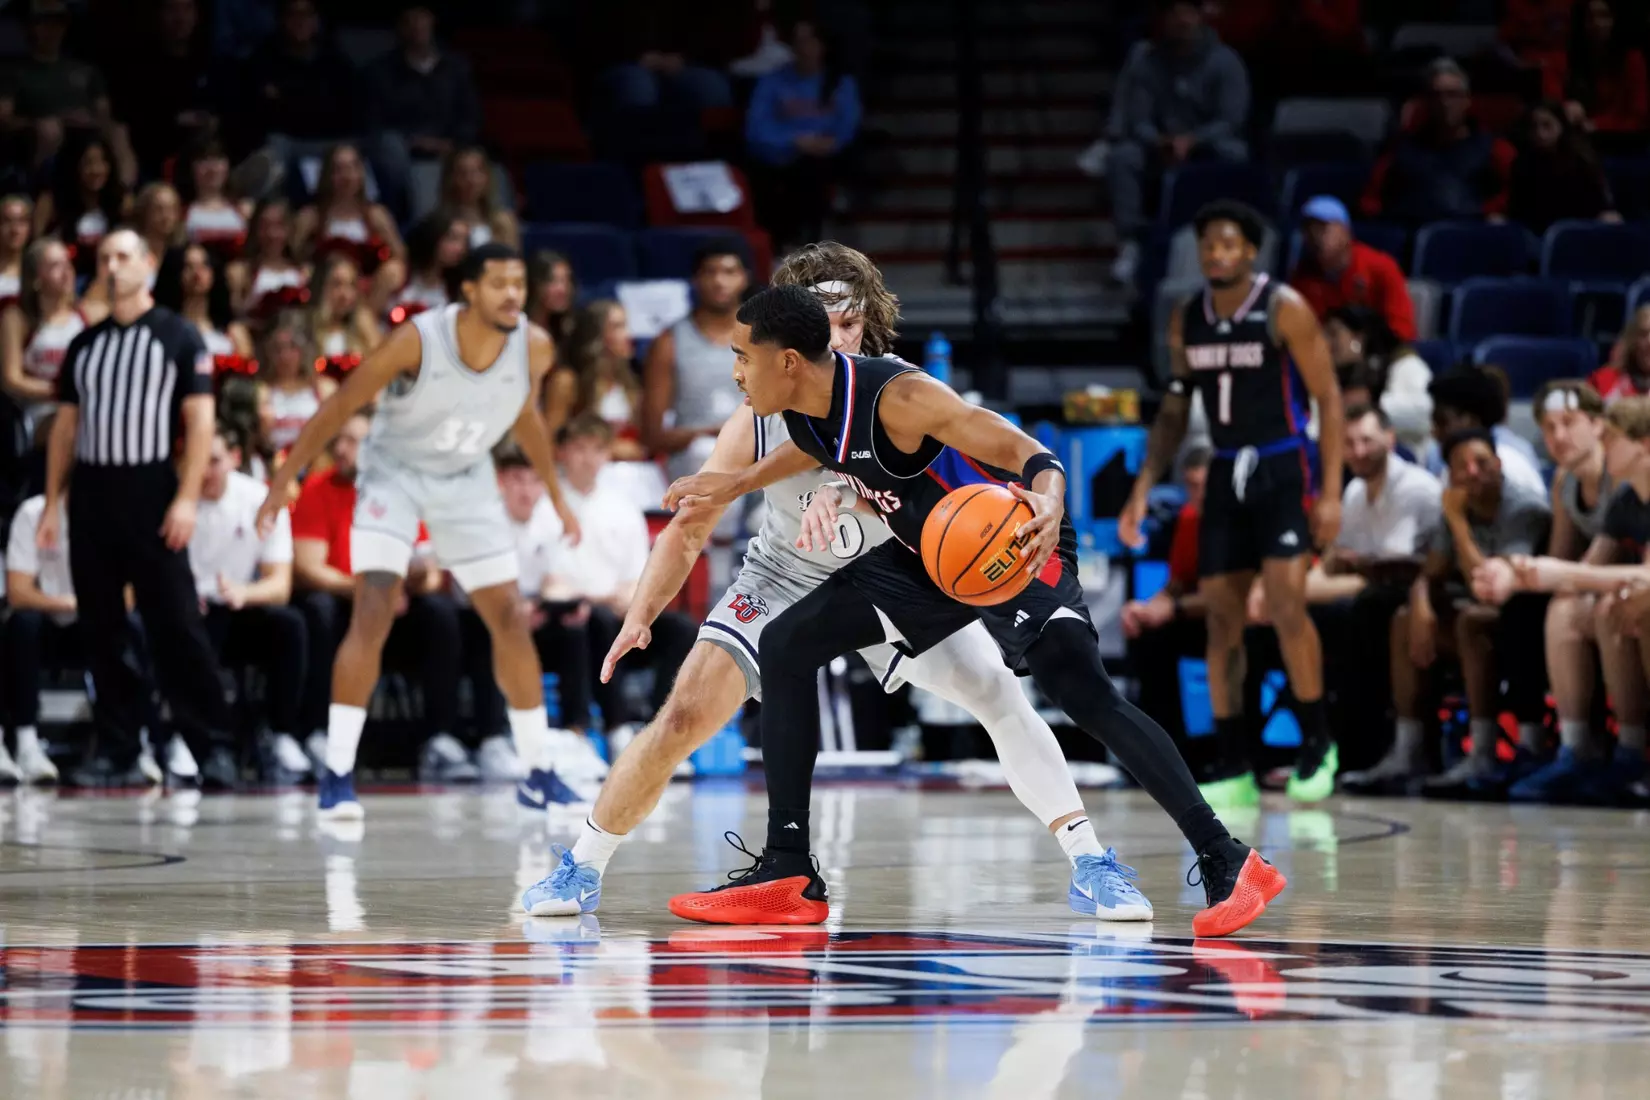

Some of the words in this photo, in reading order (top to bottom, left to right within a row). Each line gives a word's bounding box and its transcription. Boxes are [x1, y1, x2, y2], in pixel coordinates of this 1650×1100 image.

[1218, 372, 1232, 425] 1
[436, 419, 486, 454] 32
[829, 512, 865, 560] 0
